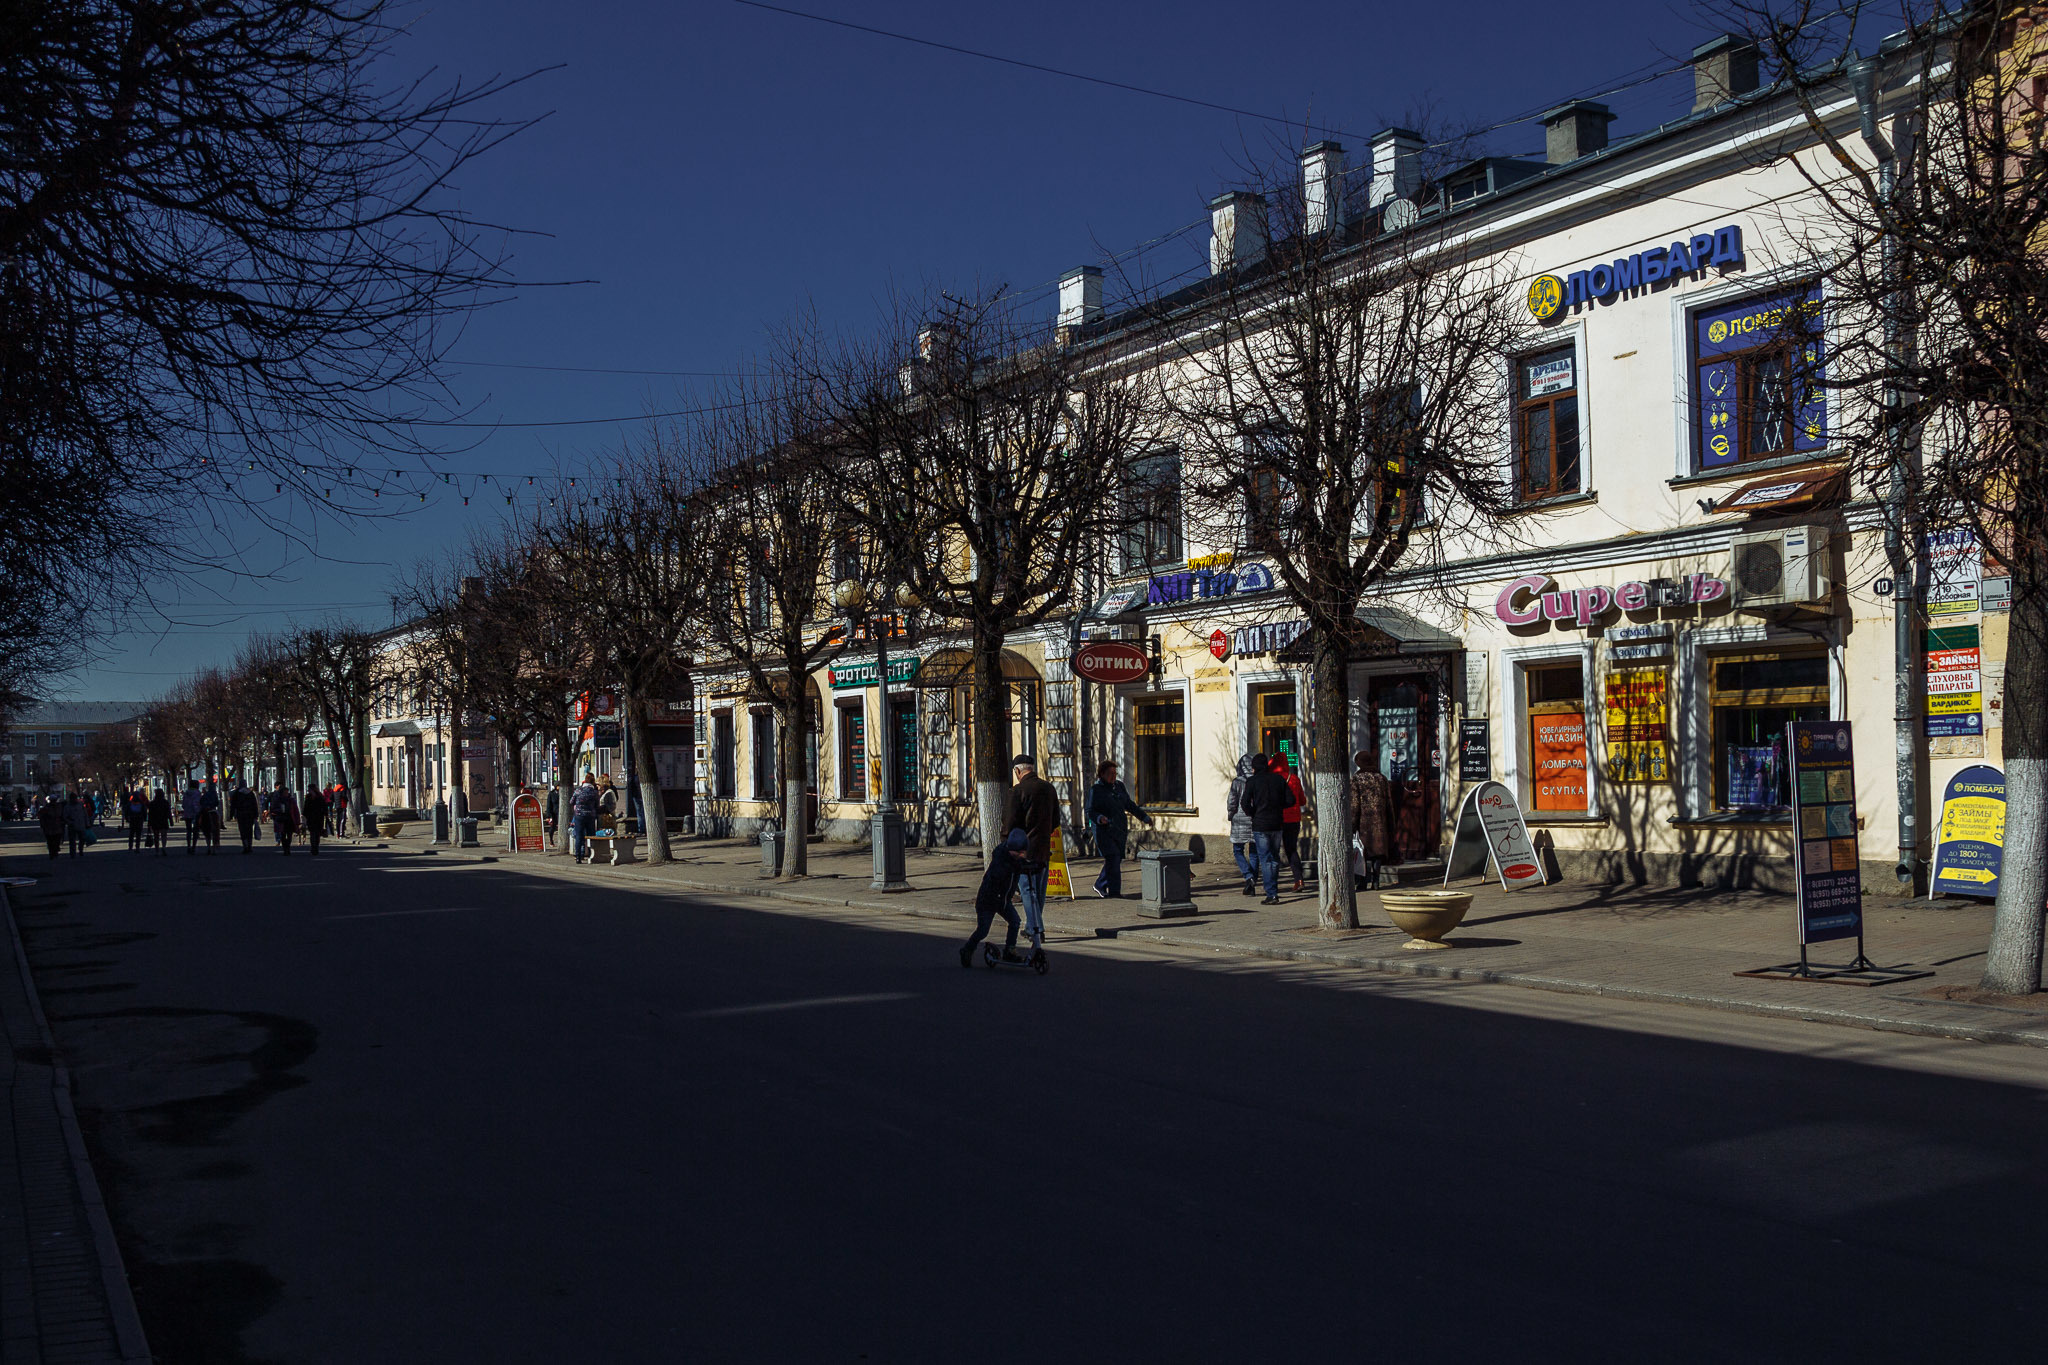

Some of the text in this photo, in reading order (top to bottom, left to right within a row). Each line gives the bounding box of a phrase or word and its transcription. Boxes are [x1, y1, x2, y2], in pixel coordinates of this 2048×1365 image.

[1565, 225, 1744, 306] ЛОМБАРД
[1729, 299, 1819, 336] ЛОМБ
[1876, 582, 1890, 592] 10
[1943, 585, 1952, 593] 10
[1936, 592, 1971, 601] оборная
[1620, 628, 1648, 637] СУМКИ
[1620, 648, 1651, 657] ЗОЛОТО
[1083, 656, 1144, 670] ОПТИКА
[1939, 655, 1978, 666] ЗАЙМЫ
[836, 662, 912, 682] ФОТОЦНТР
[1927, 673, 1973, 683] СЛУХОВЫЕ
[1928, 682, 1973, 692] АППАРАТЫ
[668, 700, 692, 710] TELE2
[1539, 723, 1583, 734] ЮВЕЛИРНЫЙ
[1540, 733, 1583, 743] МАГАЗИН
[1541, 759, 1584, 769] ЛОМБАРД
[1541, 785, 1585, 795] СКУПКА
[1963, 785, 2005, 794] ЛОМБАРД
[1958, 808, 1992, 818] ЗАЙМЫ
[1958, 843, 1984, 851] ОЦЕНКА
[1959, 850, 1978, 858] 1800
